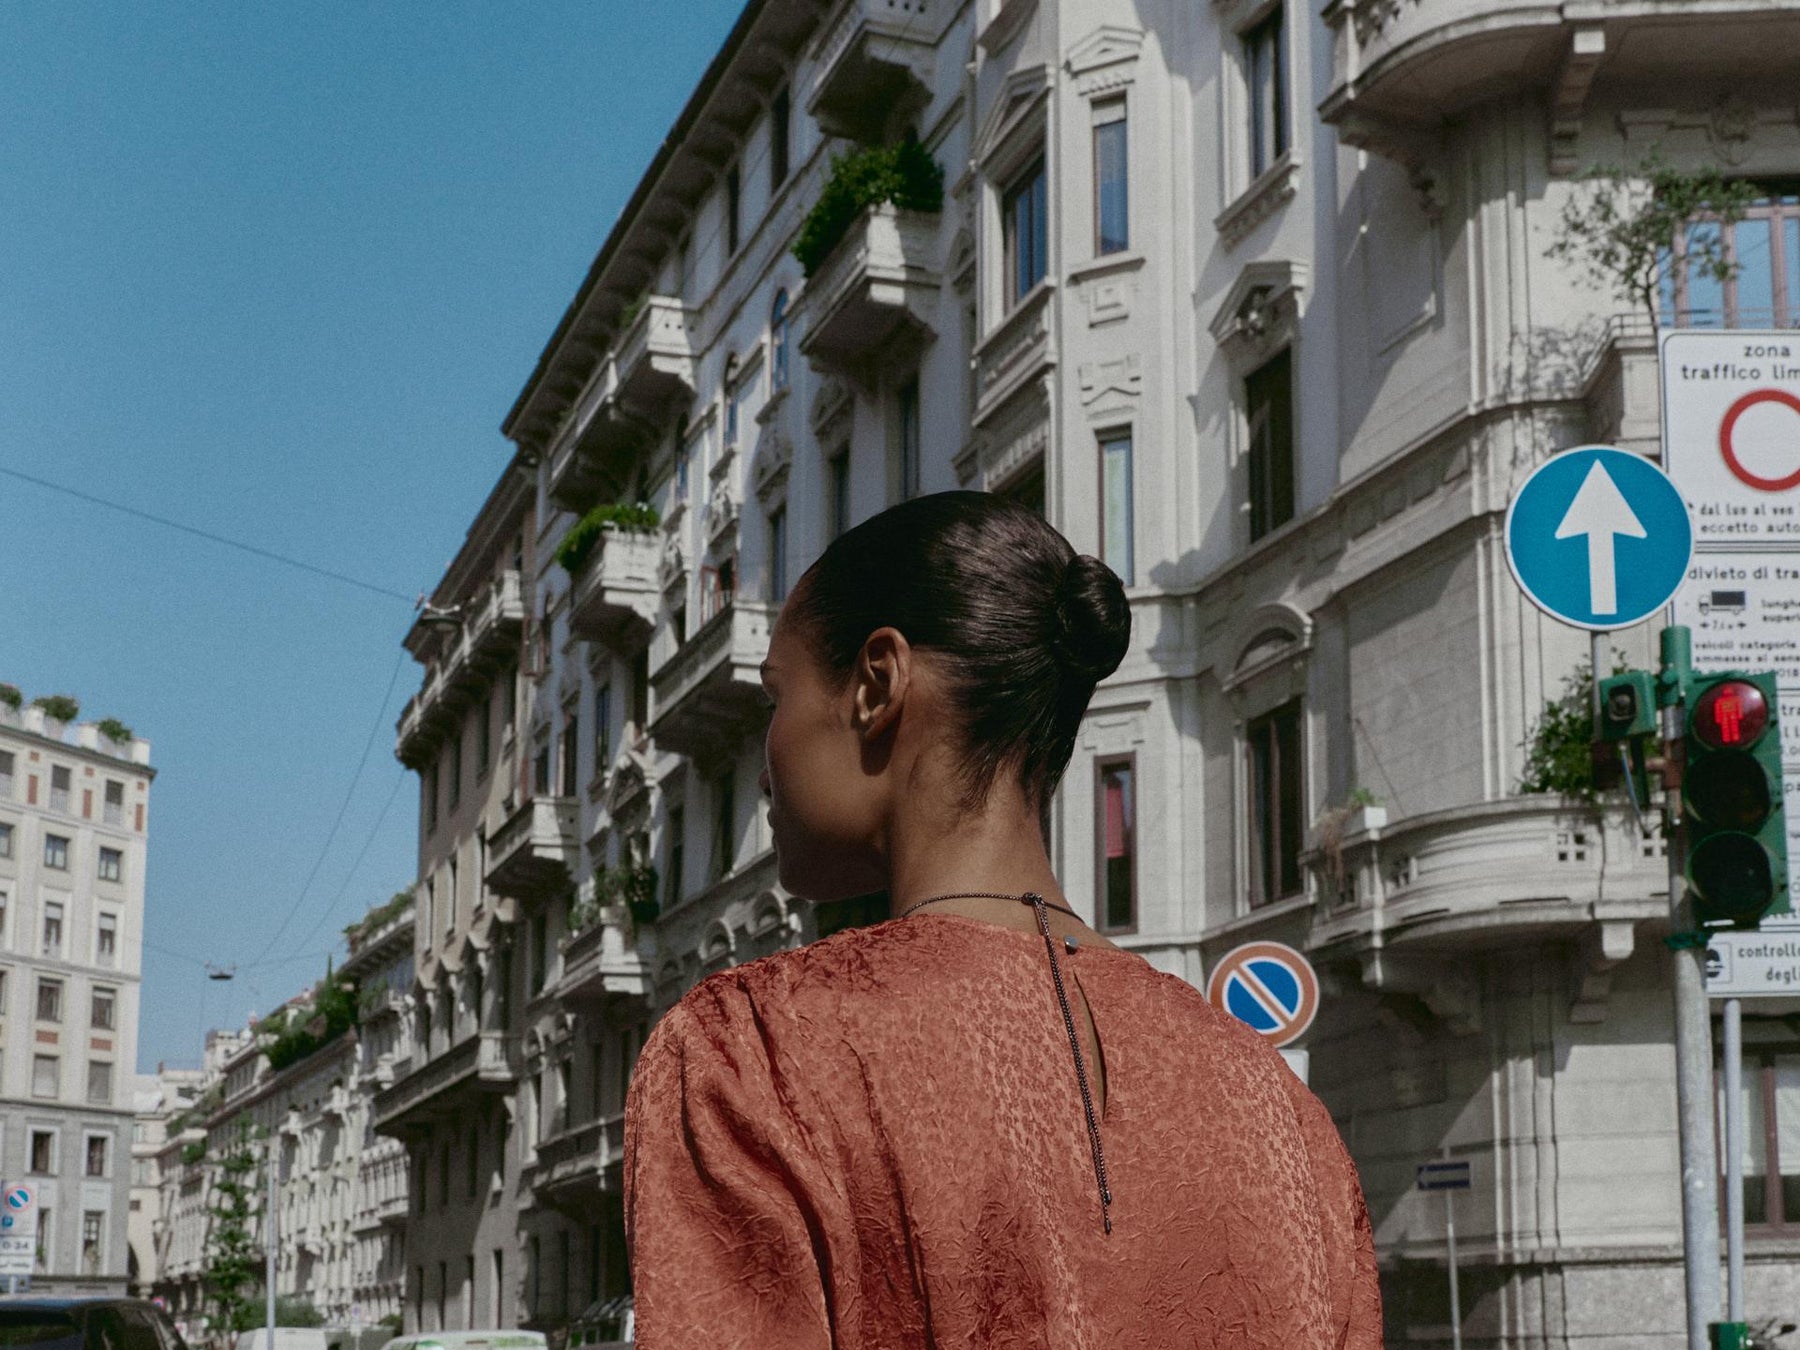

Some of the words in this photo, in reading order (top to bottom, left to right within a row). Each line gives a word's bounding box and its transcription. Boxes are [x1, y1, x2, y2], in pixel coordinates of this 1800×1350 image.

[1744, 346, 1791, 357] zona
[1681, 364, 1761, 380] traffico
[1700, 503, 1720, 516] dal
[1754, 503, 1766, 516] al
[1701, 523, 1758, 534] eccetto
[1688, 567, 1747, 579] divieto
[1753, 567, 1768, 579] di
